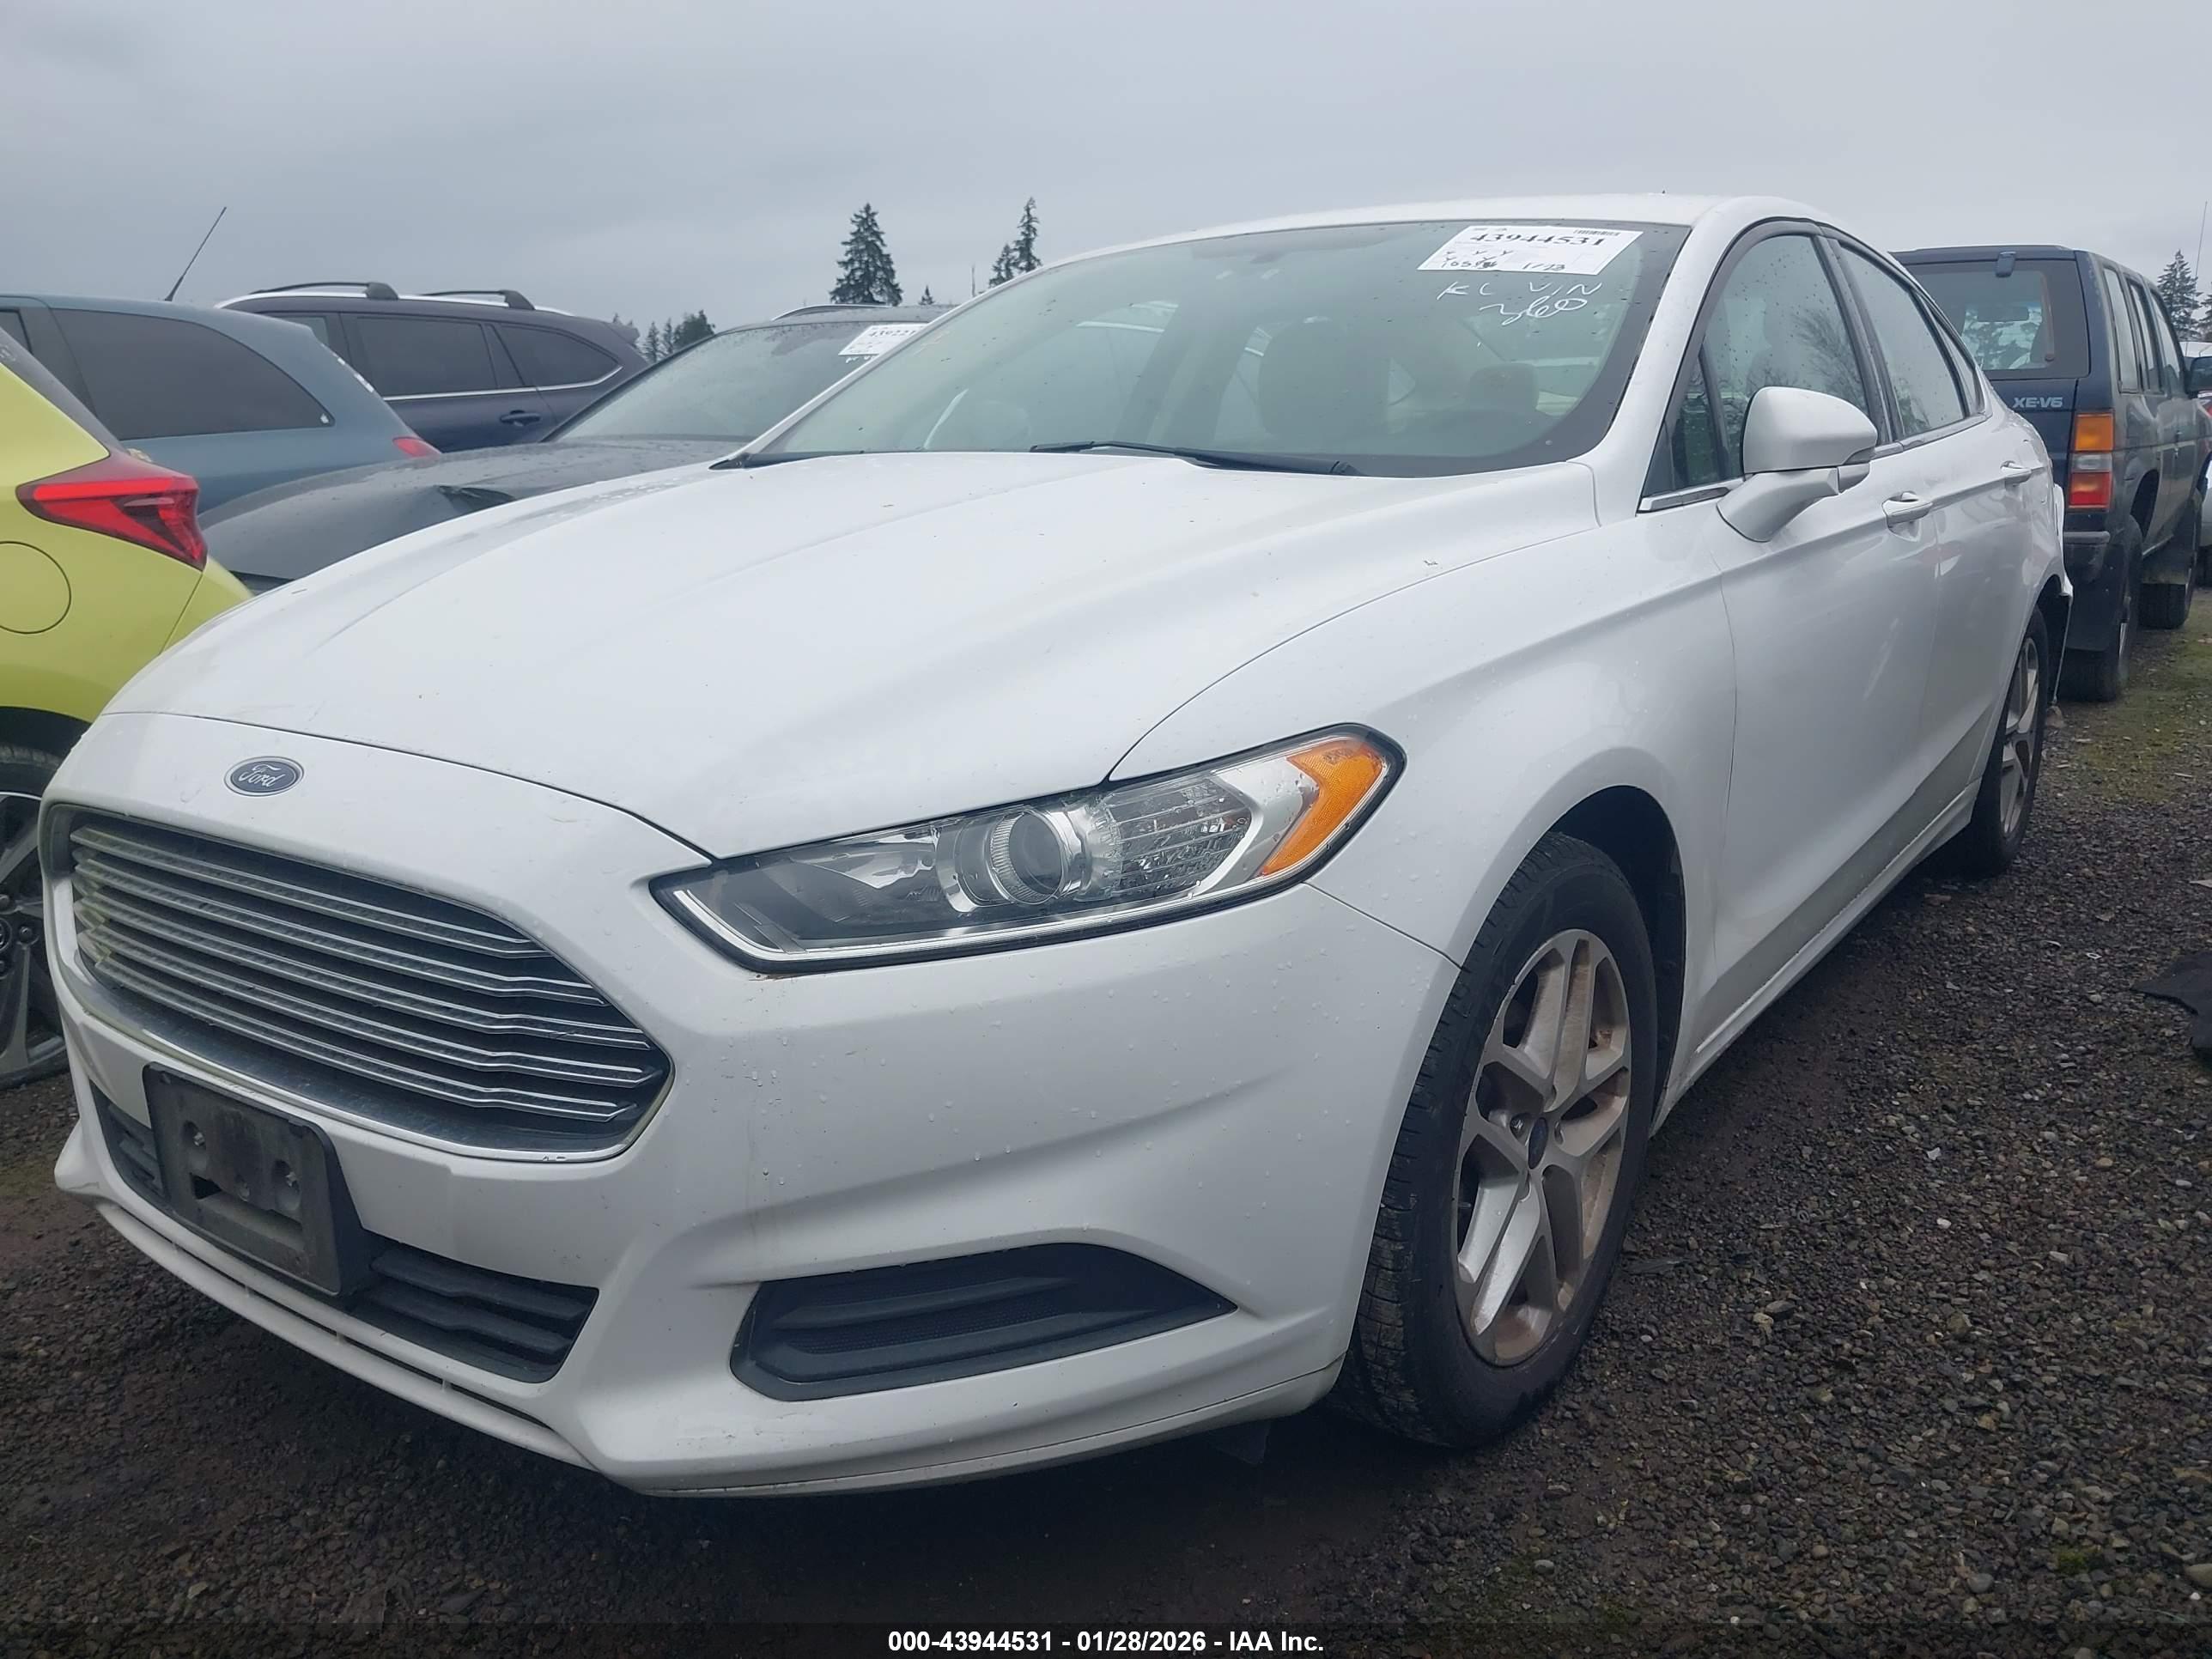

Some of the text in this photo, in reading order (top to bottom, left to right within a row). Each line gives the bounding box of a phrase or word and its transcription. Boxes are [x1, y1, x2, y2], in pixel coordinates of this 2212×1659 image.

[1470, 233, 1607, 246] 43944531
[1528, 281, 1603, 296] VIN
[238, 763, 286, 787] Ford
